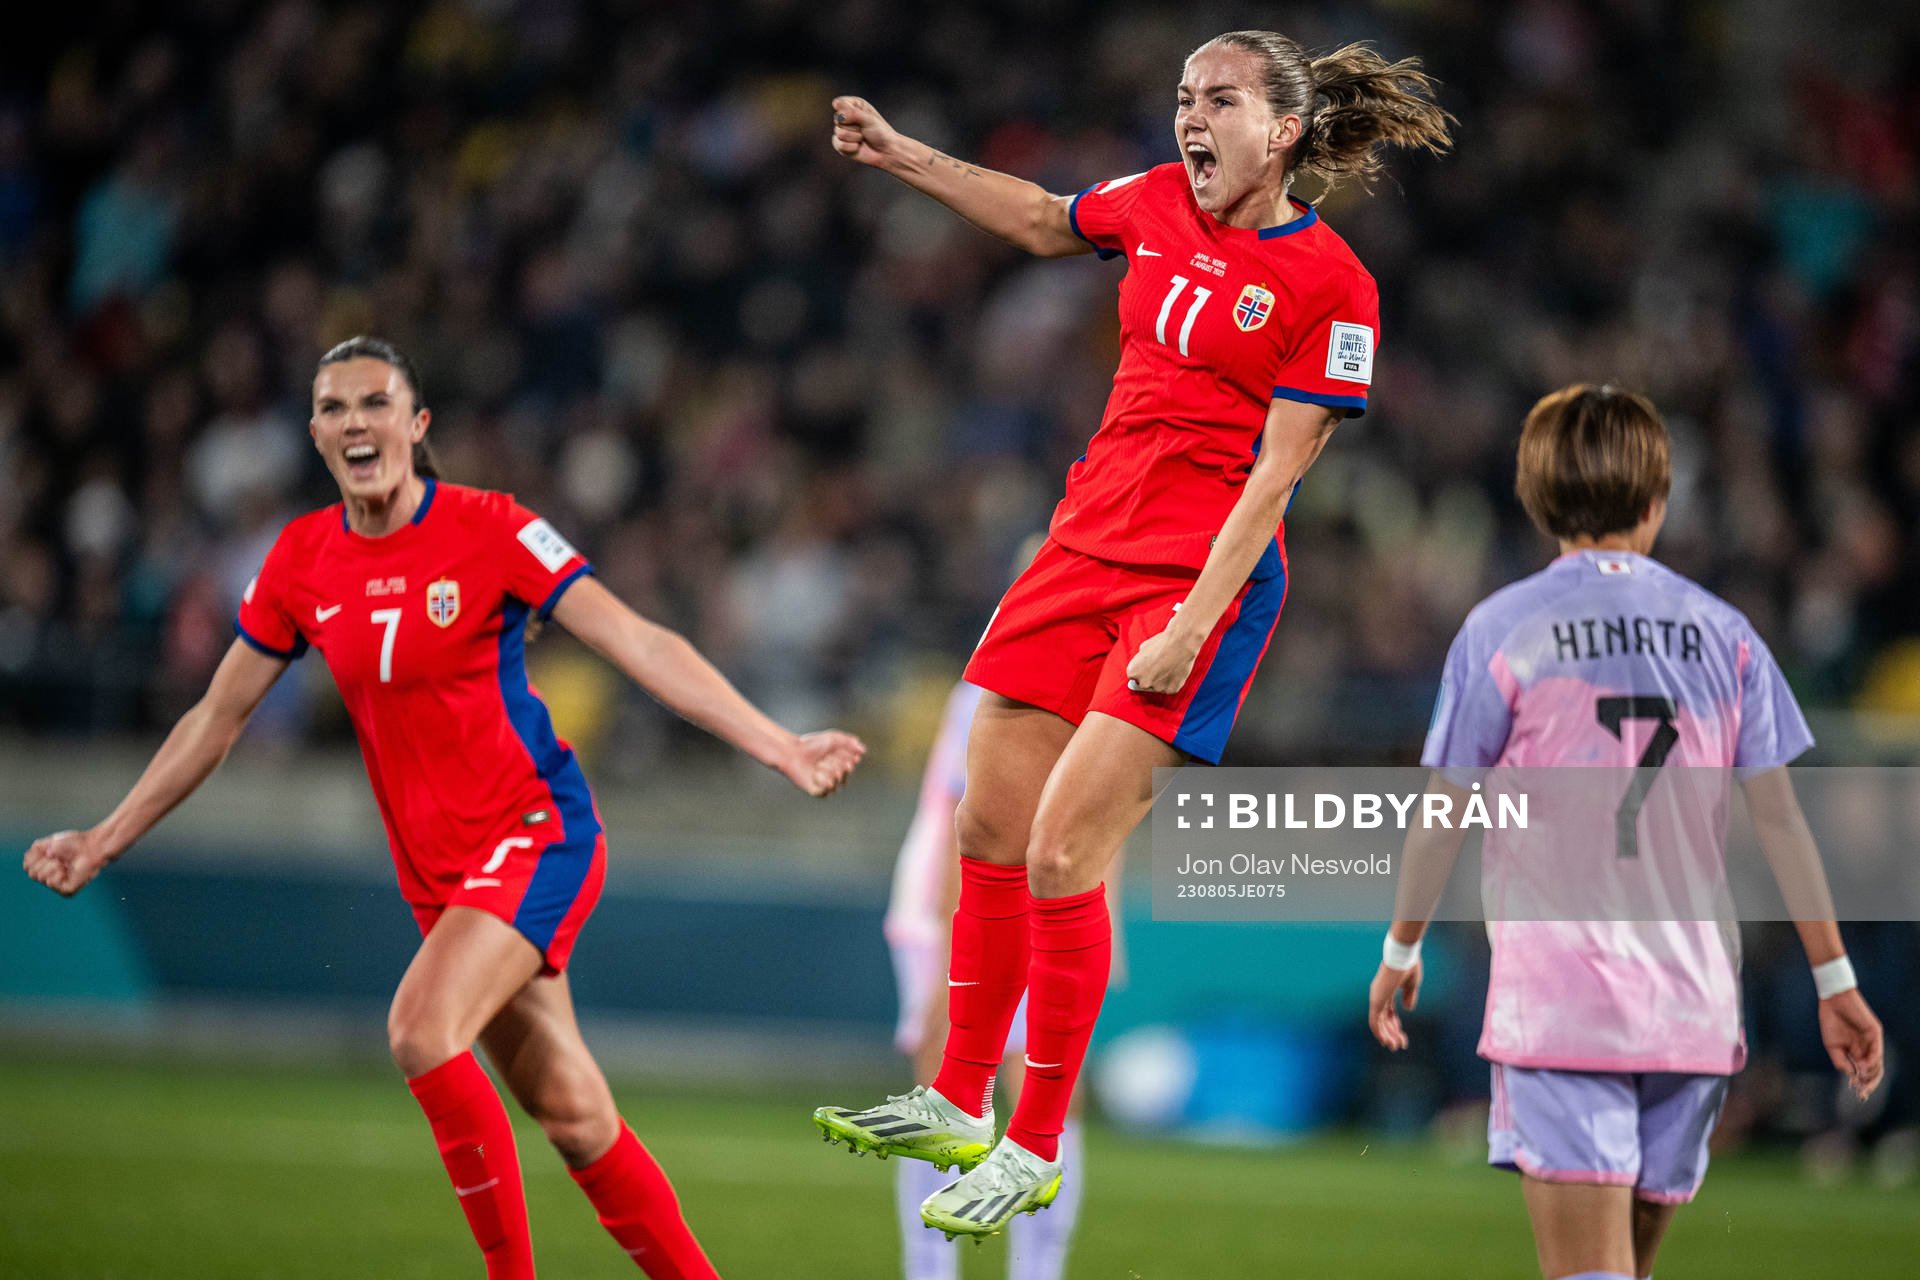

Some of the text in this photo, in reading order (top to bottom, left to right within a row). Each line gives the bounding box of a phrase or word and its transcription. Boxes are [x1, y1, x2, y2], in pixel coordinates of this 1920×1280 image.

[1156, 274, 1213, 358] 11
[1341, 332, 1367, 343] FOOTBALL
[1337, 351, 1368, 363] the World
[1340, 340, 1367, 354] UNITES
[370, 606, 403, 683] 7
[1552, 615, 1703, 663] HINATA
[1596, 696, 1680, 859] 7
